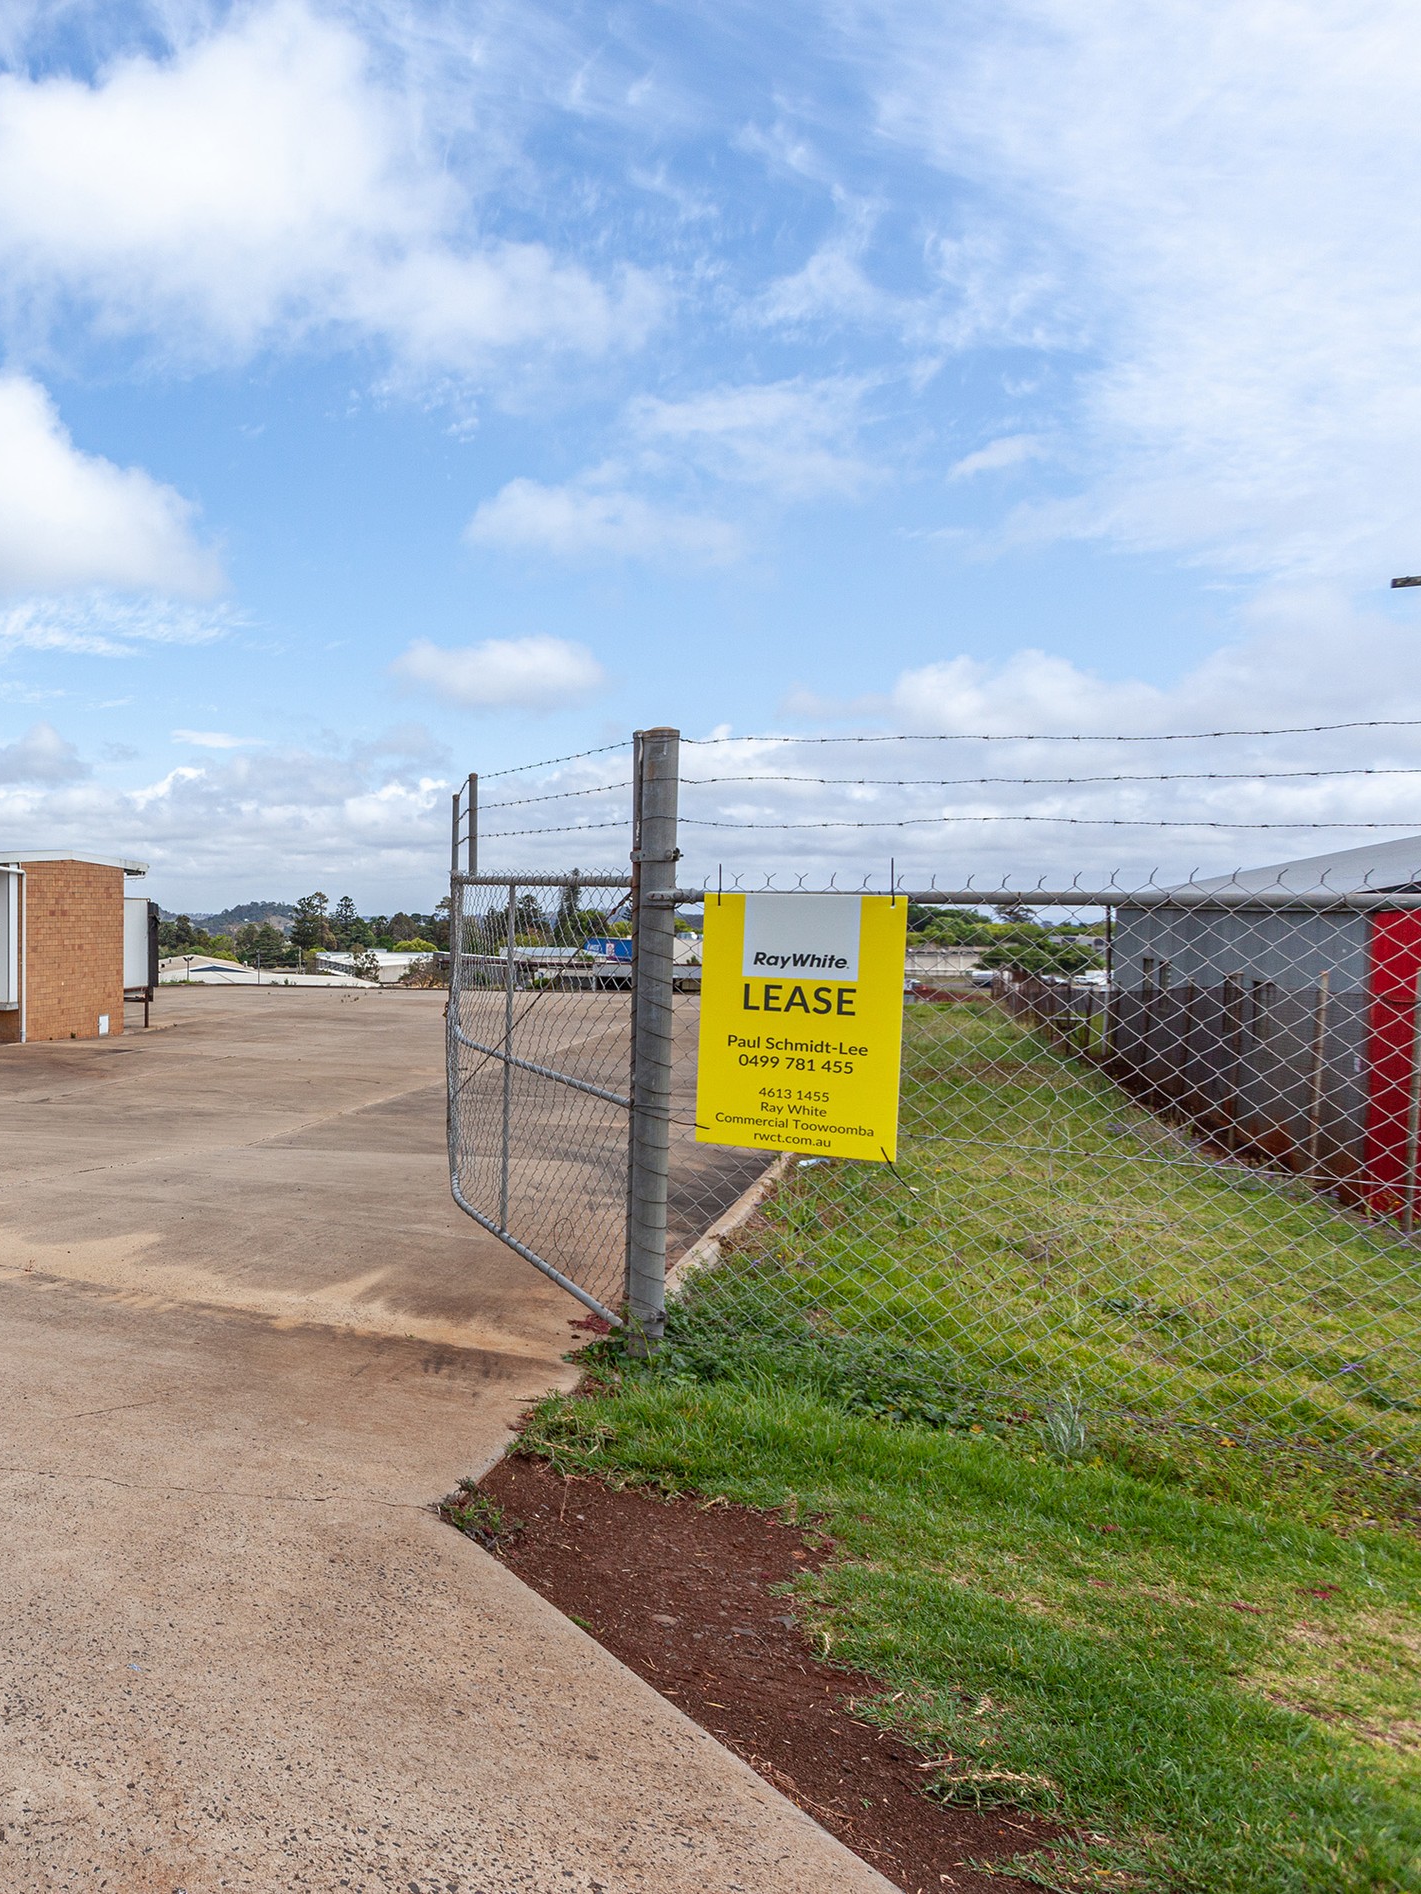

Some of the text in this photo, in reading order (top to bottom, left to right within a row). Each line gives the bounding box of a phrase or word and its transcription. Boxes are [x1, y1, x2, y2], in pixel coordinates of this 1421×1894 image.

[743, 983, 856, 1016] LEASE
[727, 1034, 869, 1057] Paul Schmidt-Lee
[738, 1054, 854, 1075] 0499 781 455
[758, 1087, 830, 1103] 4613 1455
[760, 1102, 827, 1118] Ray White
[715, 1112, 875, 1138] Commercial Toowoomba
[753, 1131, 831, 1148] rwct.com.au
